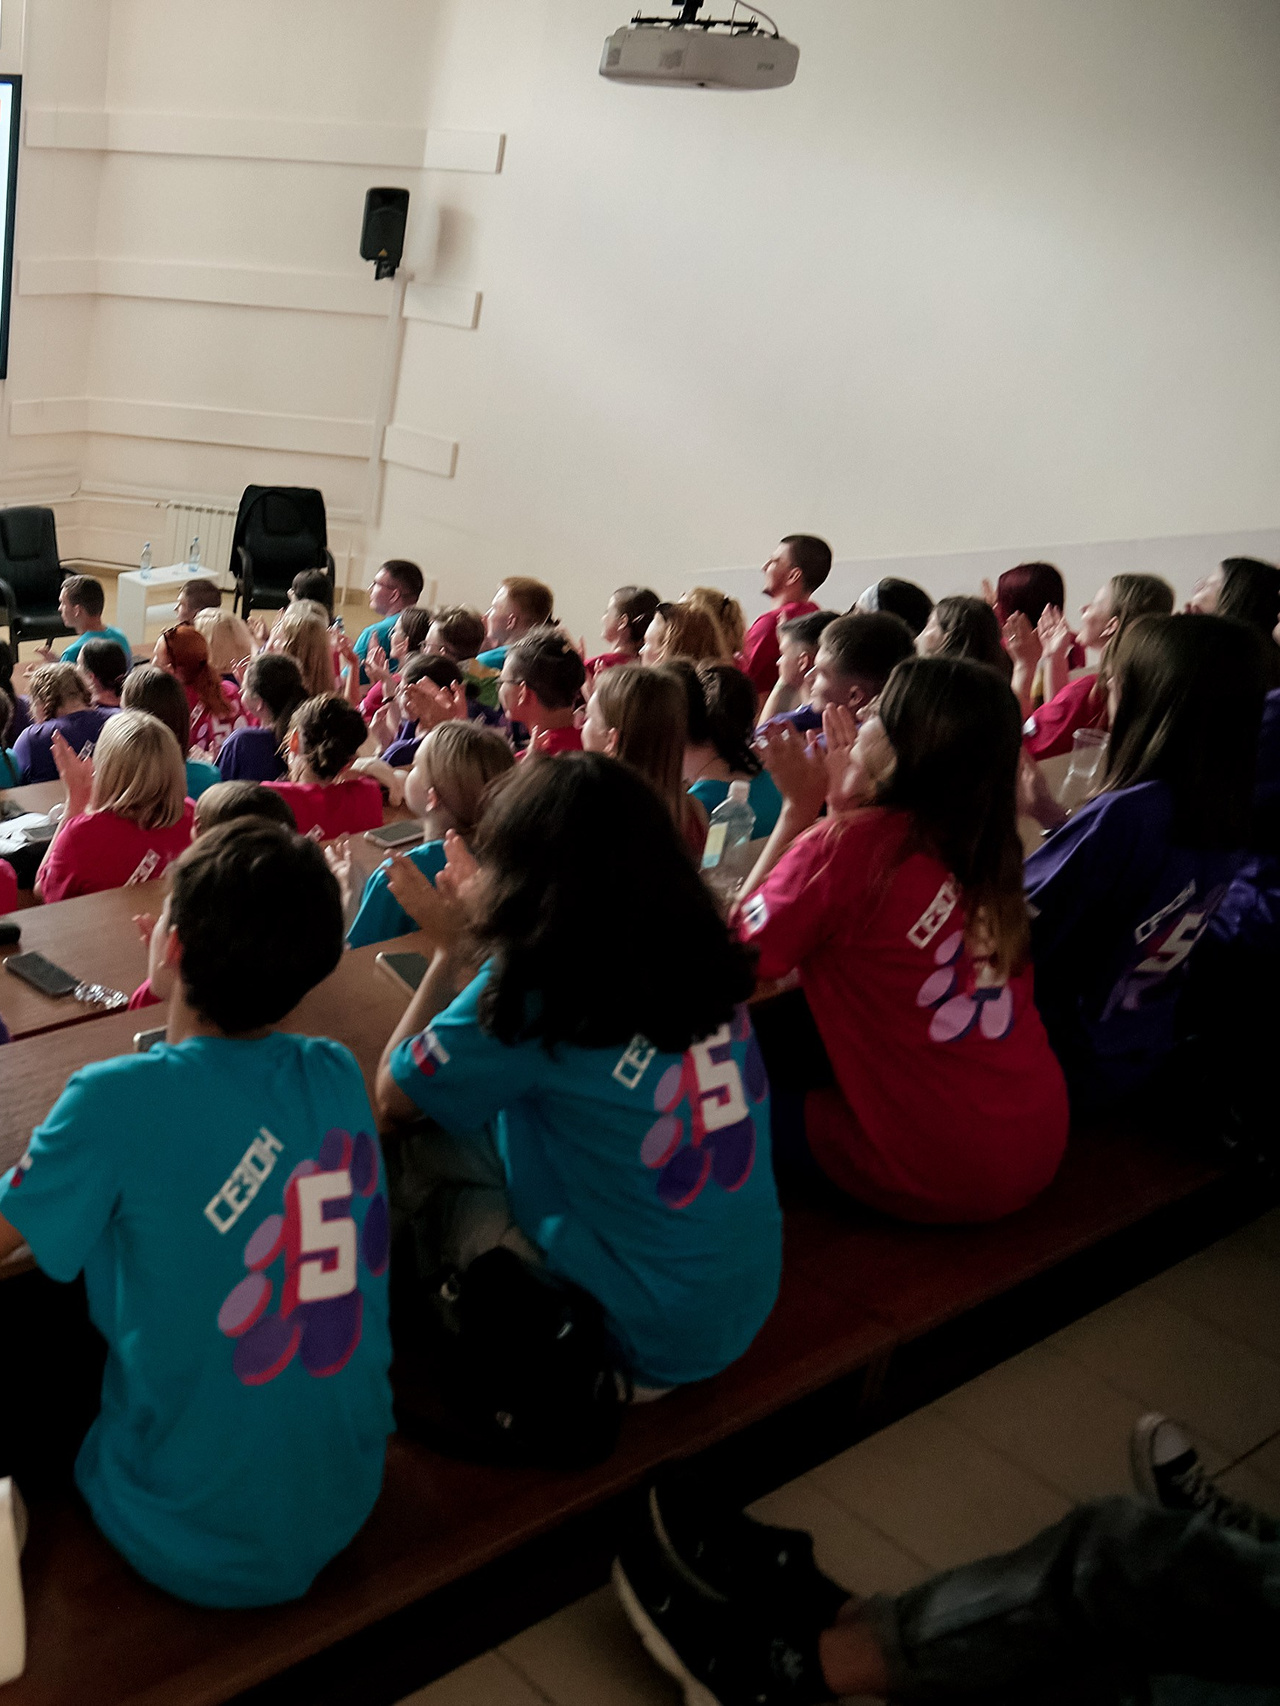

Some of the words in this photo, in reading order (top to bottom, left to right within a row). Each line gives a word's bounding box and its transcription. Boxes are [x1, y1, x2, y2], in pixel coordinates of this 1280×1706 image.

[691, 1023, 750, 1133] 5
[204, 1126, 285, 1235] СЕЗОН
[297, 1169, 358, 1302] 5
